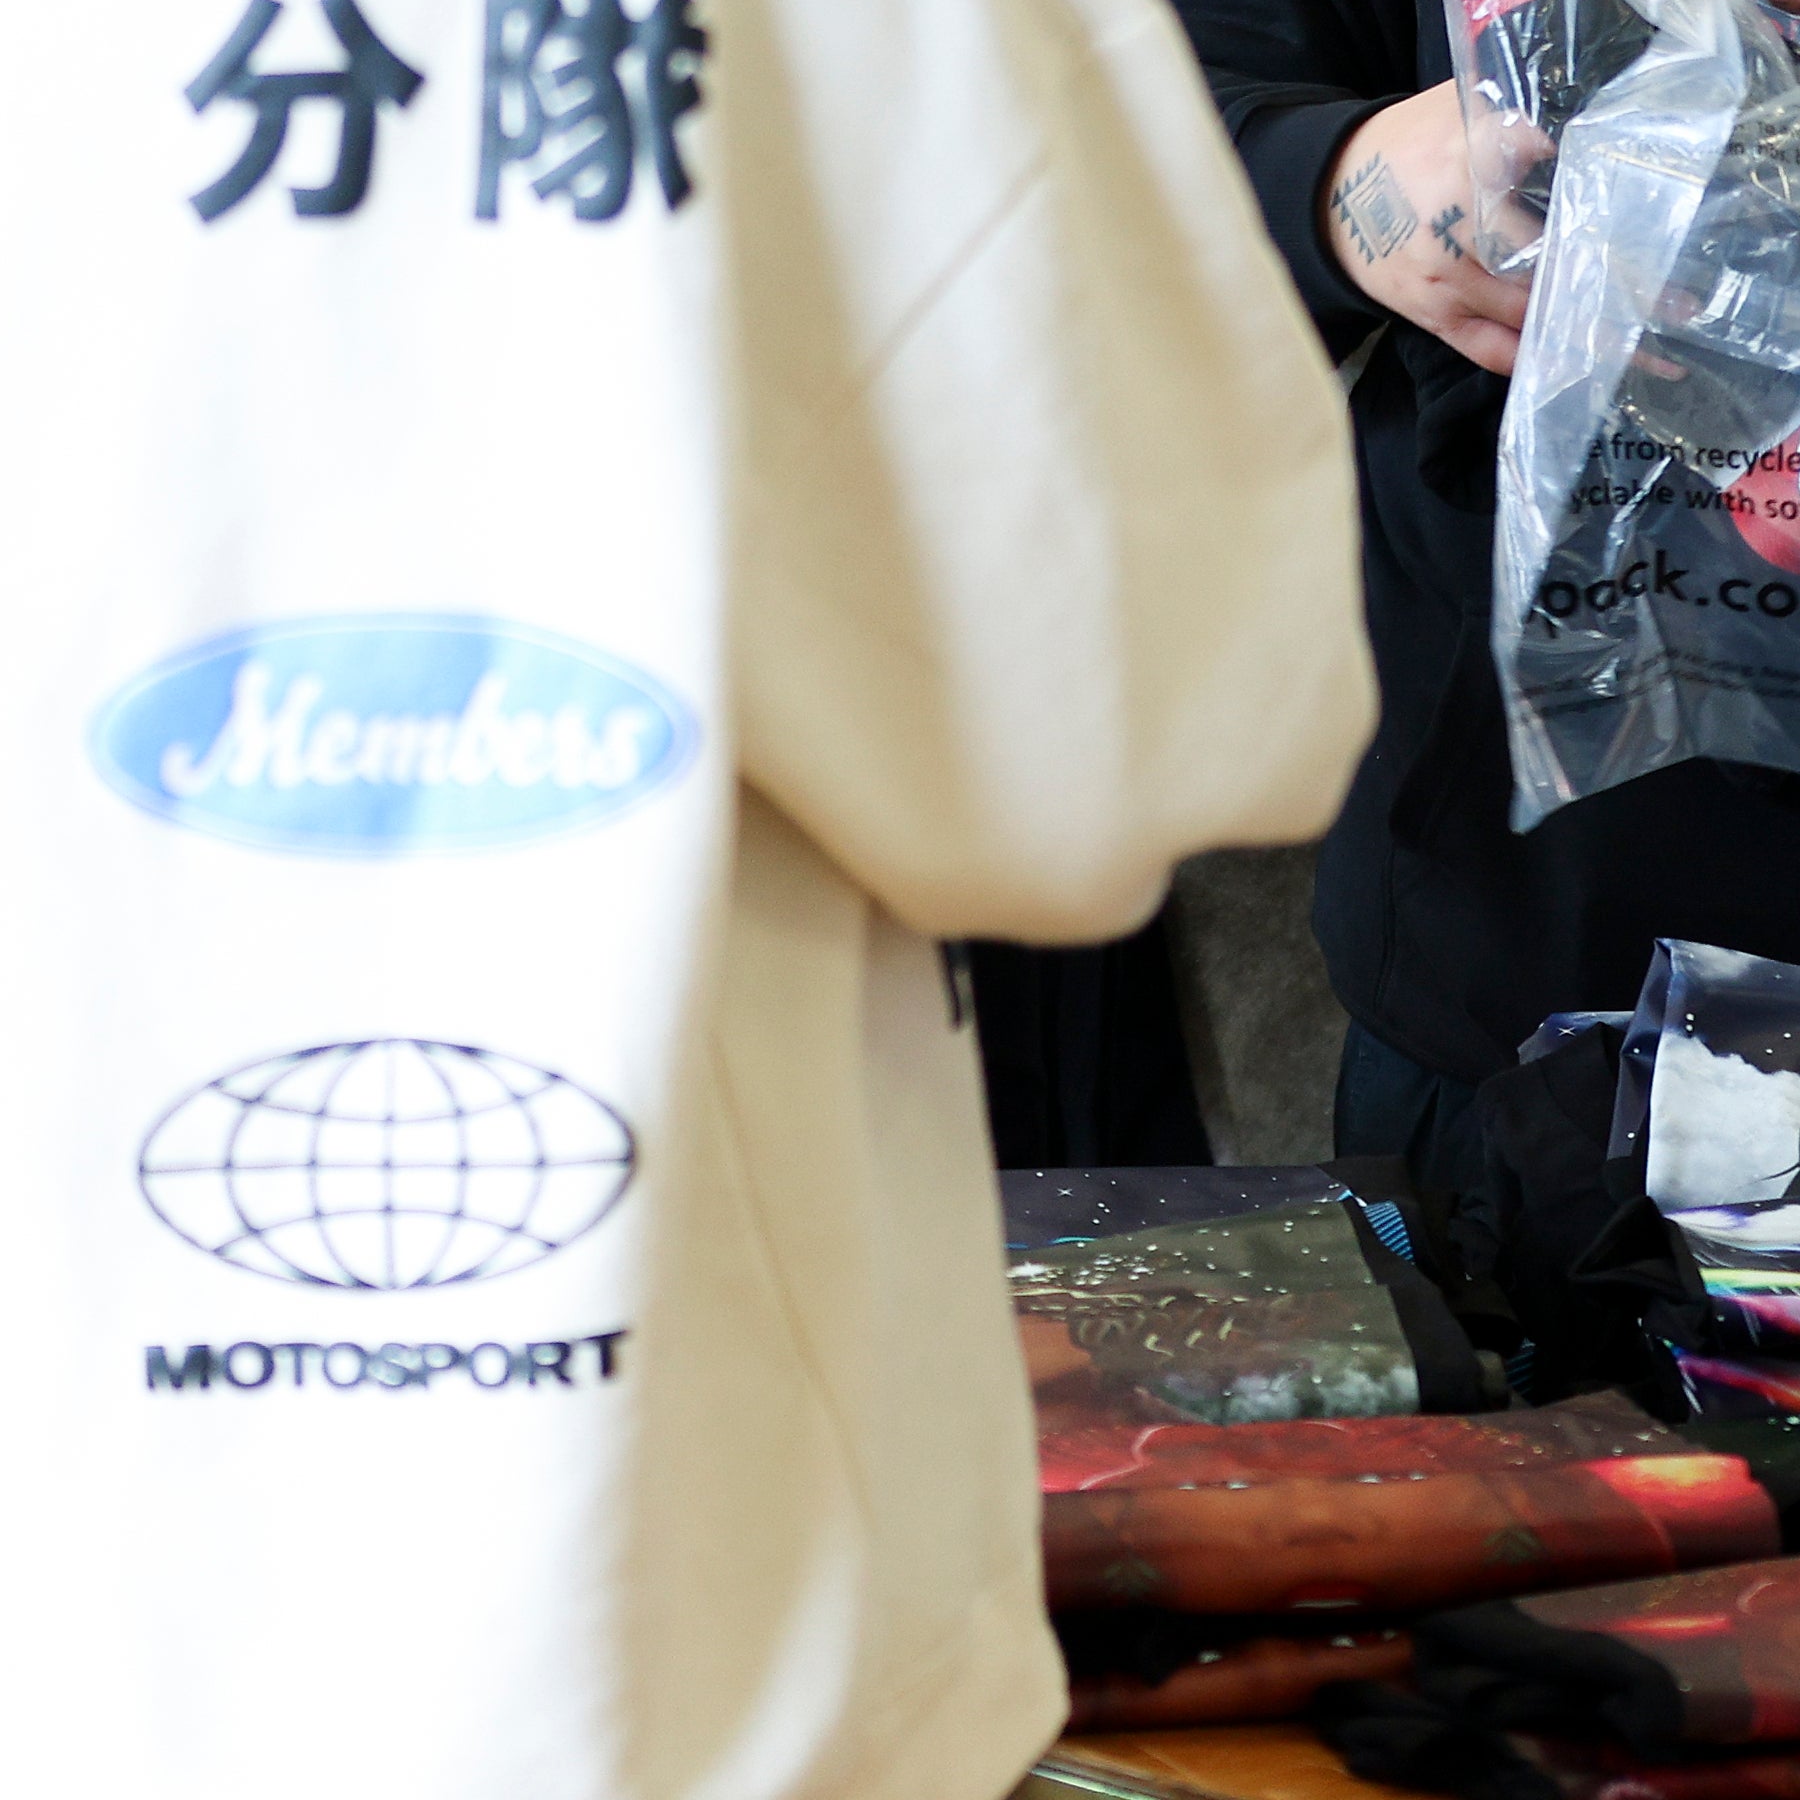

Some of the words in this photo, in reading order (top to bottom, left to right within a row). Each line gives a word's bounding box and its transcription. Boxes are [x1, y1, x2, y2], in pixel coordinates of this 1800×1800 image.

[1611, 433, 1685, 462] from
[1685, 483, 1756, 516] with
[158, 659, 648, 796] Members
[143, 1330, 628, 1392] MOTOSPORT
